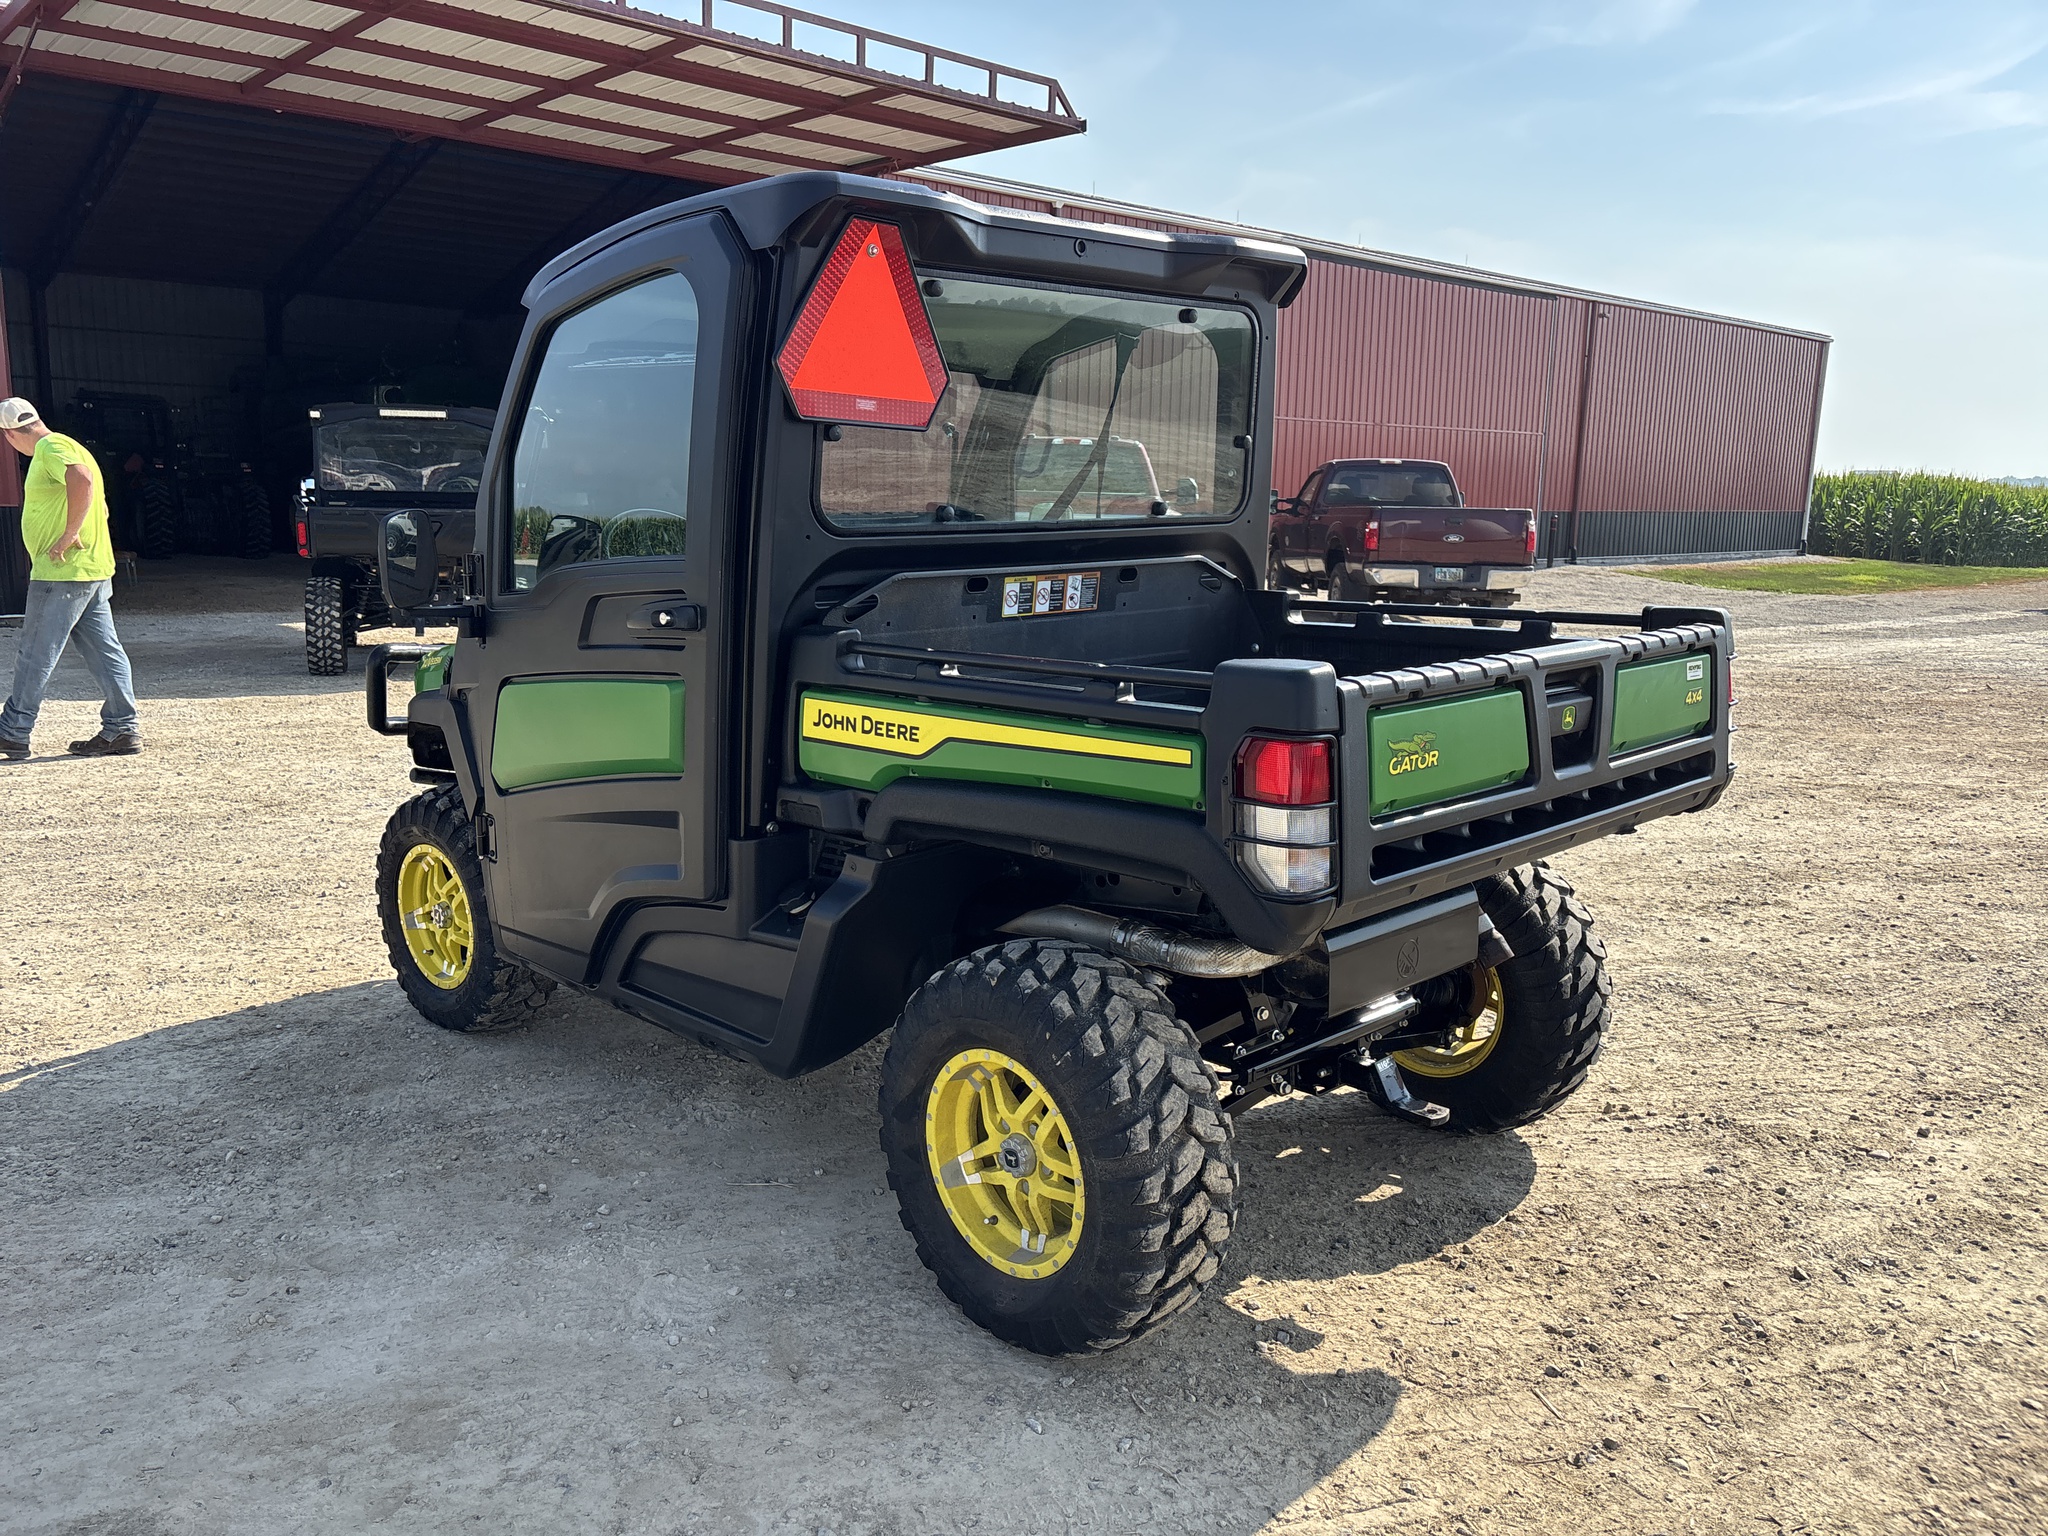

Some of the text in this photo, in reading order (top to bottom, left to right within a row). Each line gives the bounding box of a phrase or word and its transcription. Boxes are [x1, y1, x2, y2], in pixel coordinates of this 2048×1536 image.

[813, 709, 920, 743] JOHN DEERE
[1389, 750, 1439, 775] GATOR
